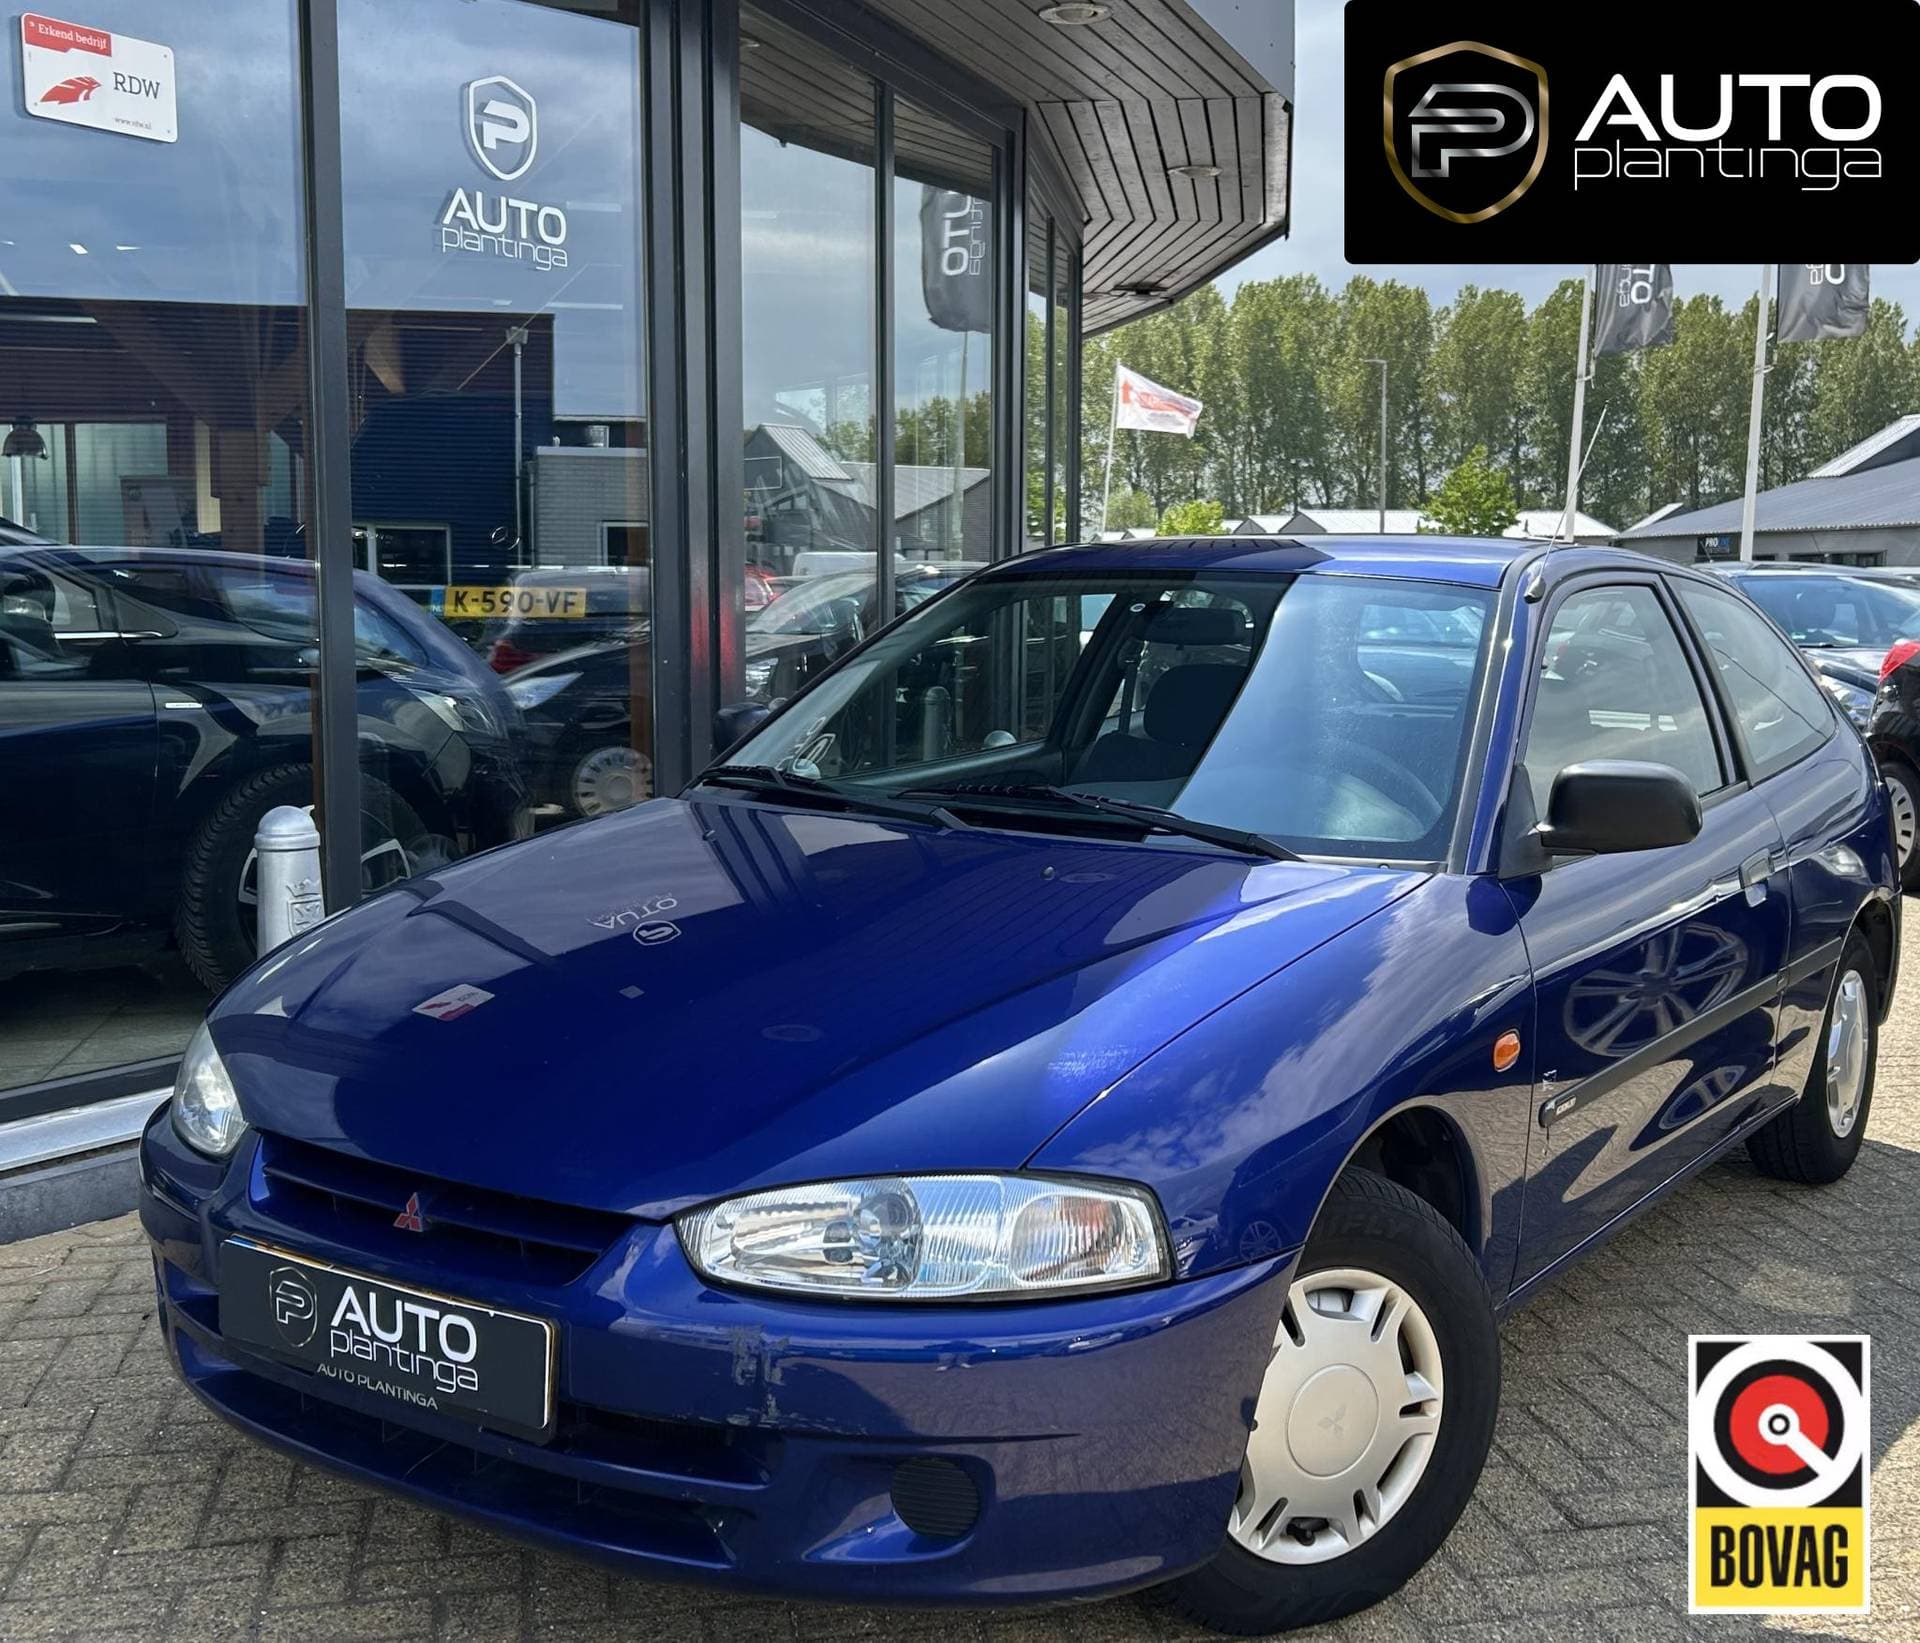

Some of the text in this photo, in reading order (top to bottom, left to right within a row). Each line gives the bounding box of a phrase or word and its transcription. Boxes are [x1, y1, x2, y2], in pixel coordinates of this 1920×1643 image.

[38, 23, 107, 50] Erkend bedrijf
[113, 71, 160, 99] RDW
[442, 187, 567, 246] AUTO
[442, 226, 568, 272] plantinga
[453, 590, 578, 614] K-590-VF
[331, 1286, 478, 1363] AUTO
[331, 1329, 479, 1394] plantinga
[317, 1363, 438, 1410] AUTO PLANTINGA
